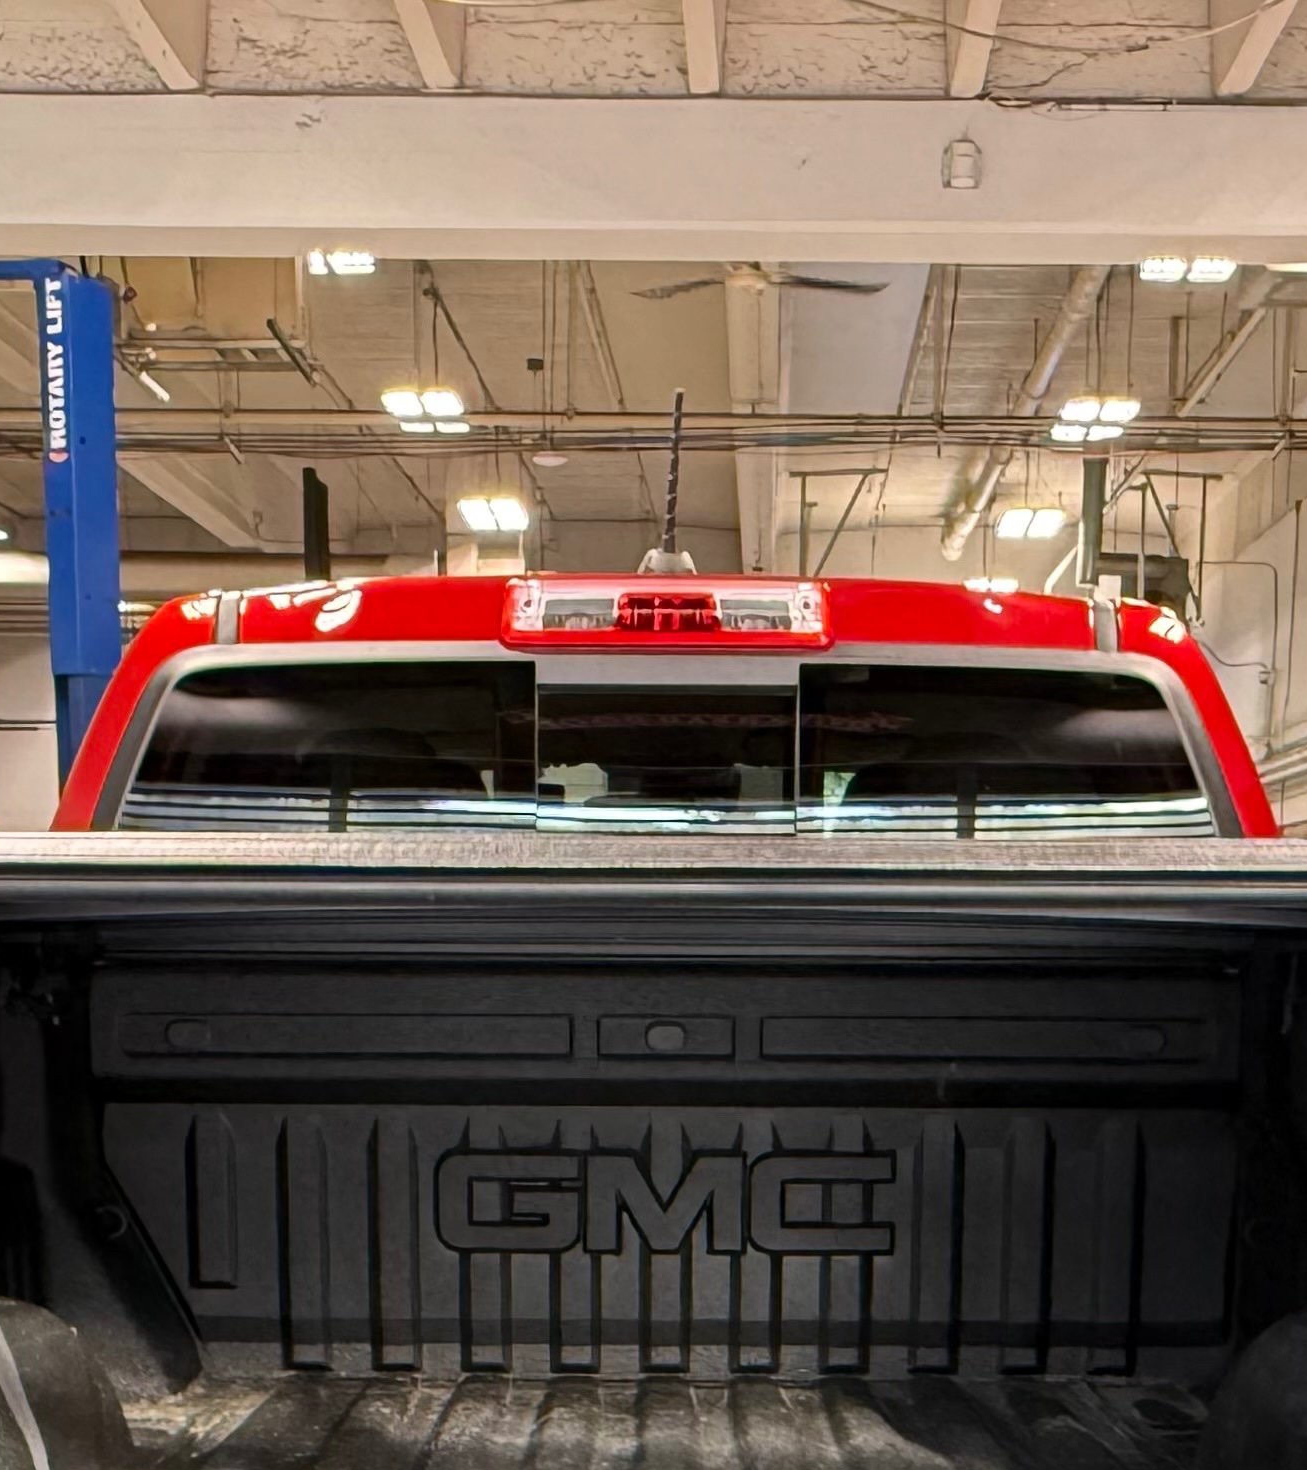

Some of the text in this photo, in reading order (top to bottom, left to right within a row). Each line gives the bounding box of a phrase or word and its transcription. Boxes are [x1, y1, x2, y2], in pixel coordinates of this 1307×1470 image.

[44, 277, 67, 449] ROTARY LIFT
[433, 1147, 897, 1256] GMC
